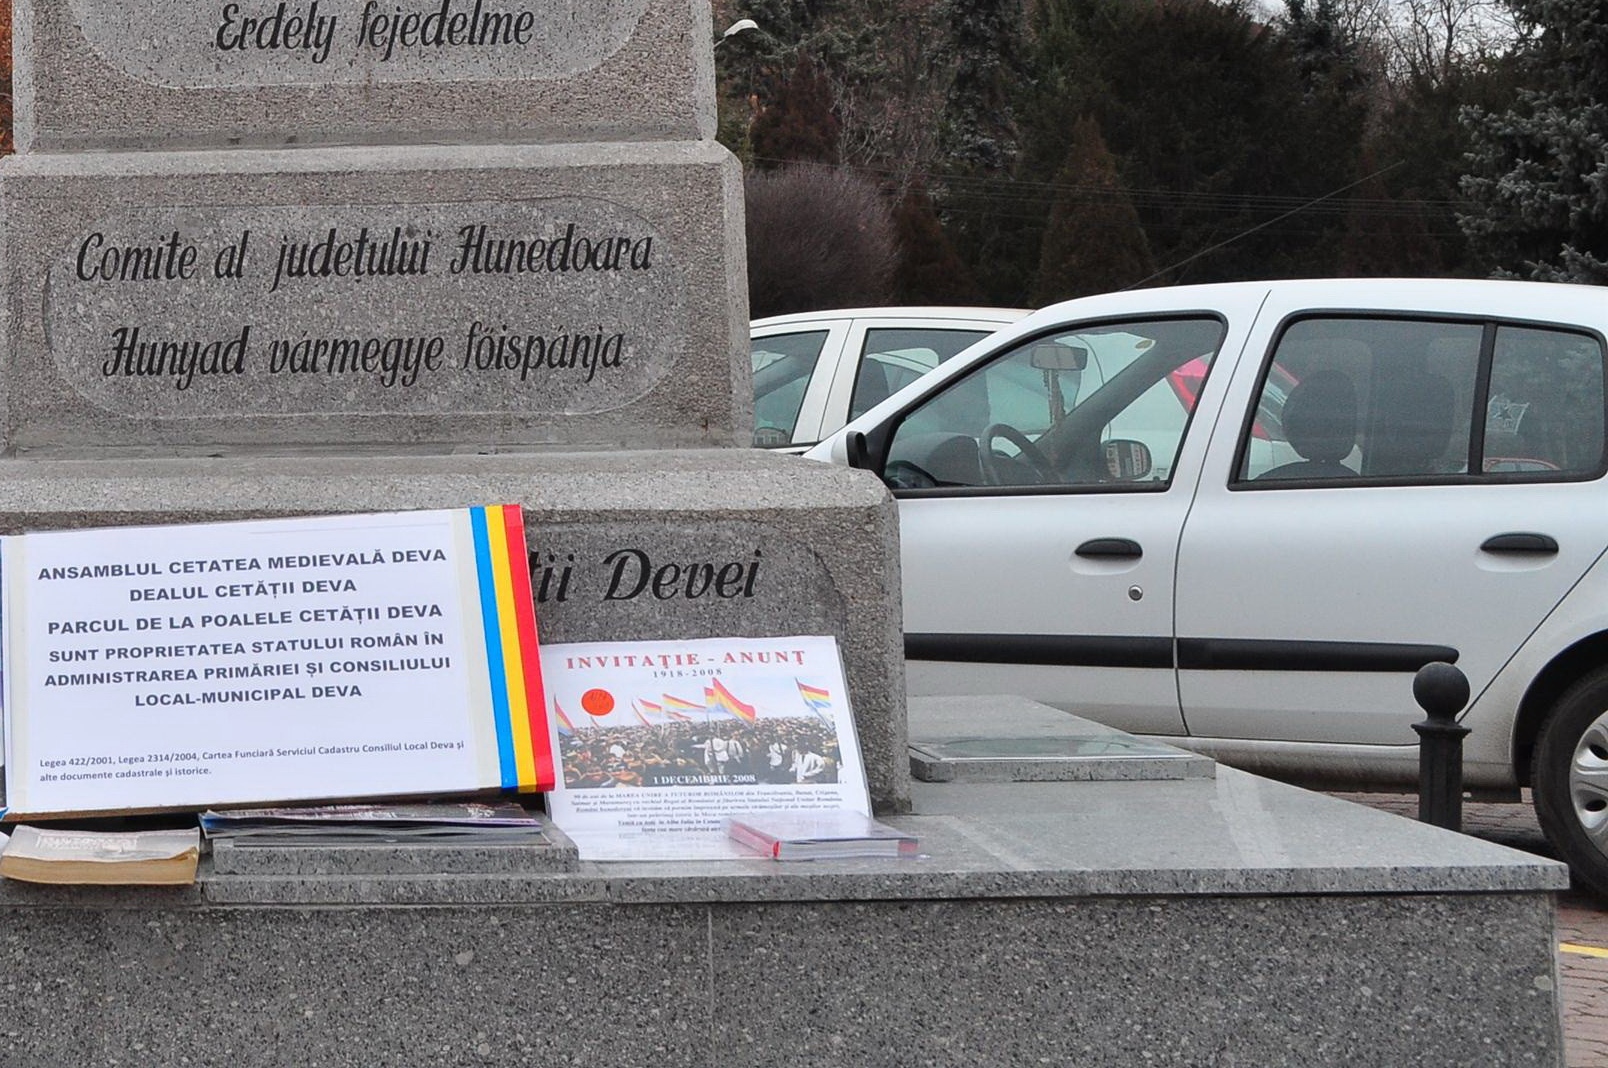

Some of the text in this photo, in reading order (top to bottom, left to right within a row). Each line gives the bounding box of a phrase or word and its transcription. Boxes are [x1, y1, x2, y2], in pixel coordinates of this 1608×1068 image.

[359, 0, 534, 62] fejedelme
[77, 232, 197, 282] Comite
[215, 232, 248, 279] al
[450, 223, 652, 277] Hunedoara
[103, 326, 250, 390] Hunyad
[269, 330, 444, 388] vármegye
[38, 549, 446, 580] ANSAMBLUL CETATEA MEDIEVALĂ DEVA
[603, 548, 761, 601] Devei
[130, 587, 208, 601] DEALUL
[303, 580, 356, 593] DEVA
[49, 619, 129, 634] PARCUL
[137, 618, 162, 630] DE
[169, 617, 194, 629] LA
[202, 611, 292, 627] POALELE
[388, 605, 442, 618] DEVA
[50, 632, 443, 662] SUNT PROPRIETATEA STATULUI ROMÂN ÎN
[45, 669, 197, 686] ADMINISTRAREA
[204, 663, 299, 679] PRIMĂRIEI
[330, 657, 450, 673] CONSILIULUI
[653, 668, 722, 678] 1918-2008
[136, 686, 361, 706] LOCAL-MUNICIPAL DEVA
[40, 760, 66, 768] Legea
[69, 757, 115, 766] 422/2001,
[119, 756, 144, 765] Legea
[148, 753, 199, 762] 2314/2004,
[277, 747, 315, 756] Serviciul
[318, 746, 359, 754] Cadastru
[362, 743, 401, 752] Consiliul
[404, 742, 428, 750] Local
[60, 772, 112, 780] documente
[115, 769, 162, 778] cadastrale
[175, 767, 211, 775] istorice.
[654, 774, 756, 784] 1 DECEMBRIE 2008
